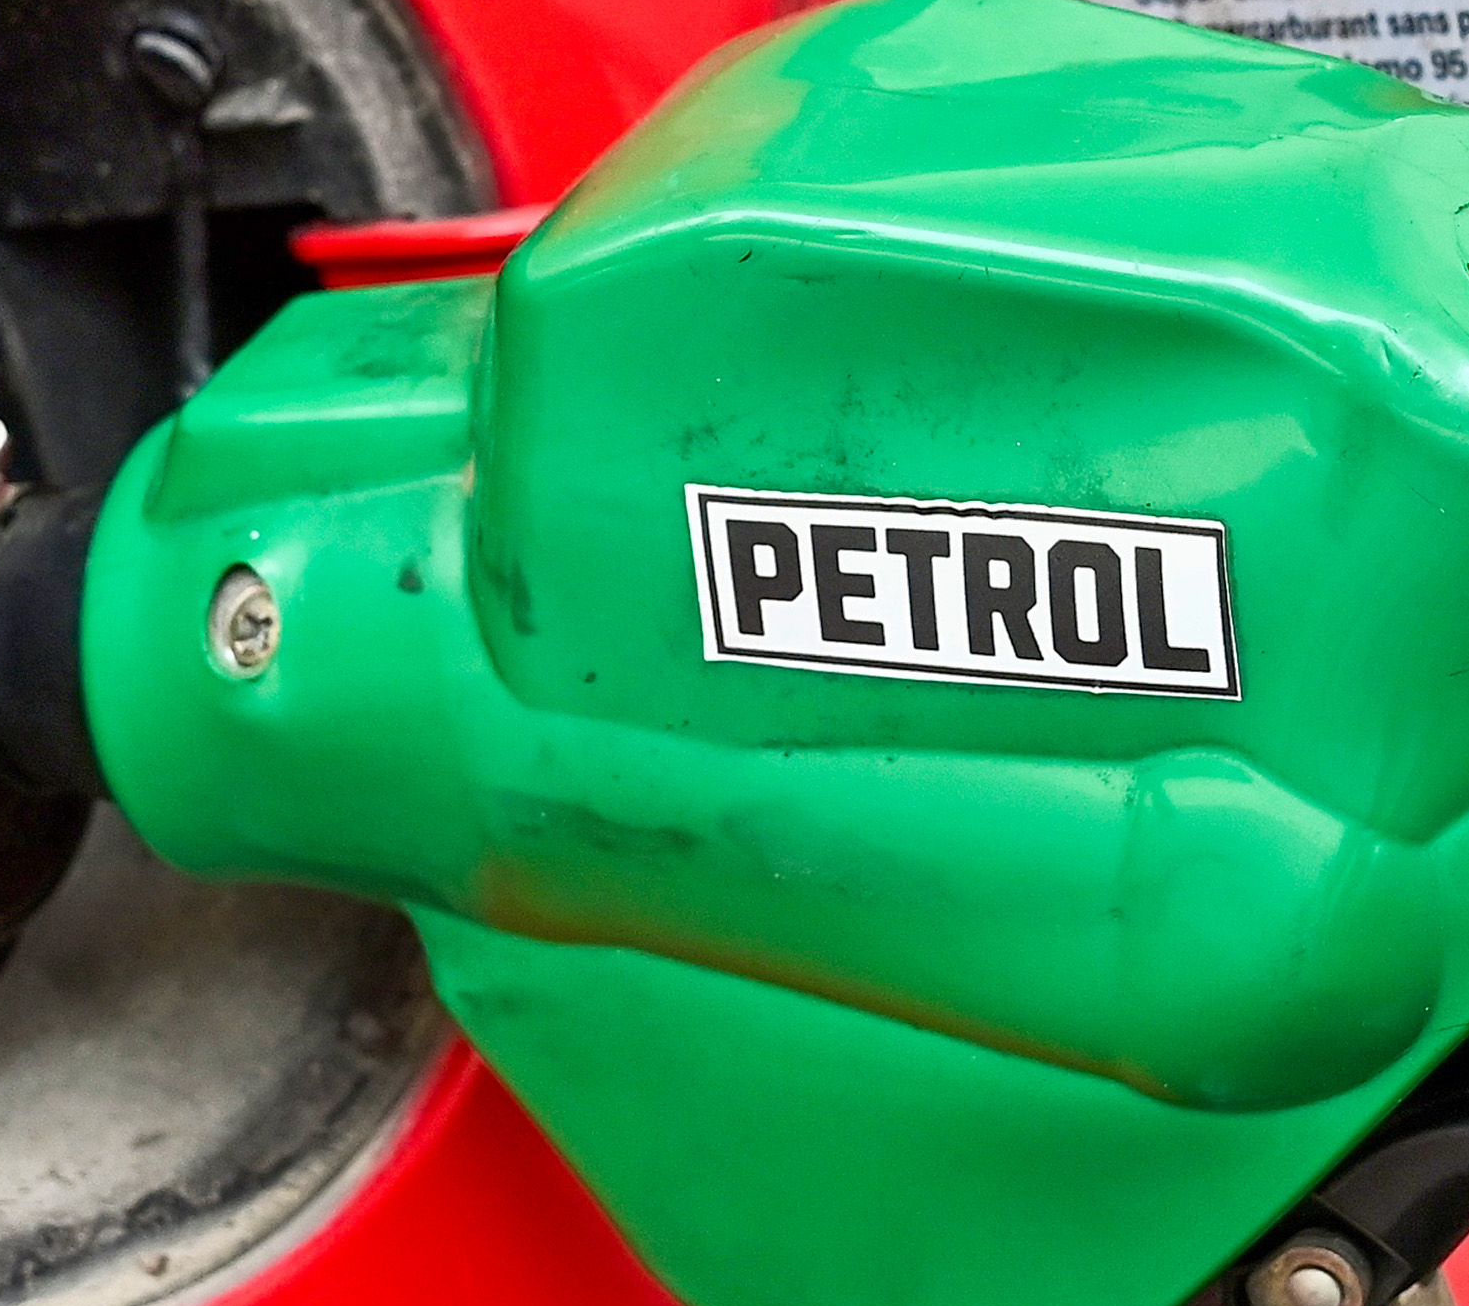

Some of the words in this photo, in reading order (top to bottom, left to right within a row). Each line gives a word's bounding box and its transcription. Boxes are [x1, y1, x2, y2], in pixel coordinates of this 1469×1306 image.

[1388, 11, 1450, 36] sans
[1431, 48, 1468, 81] 95
[725, 519, 1211, 673] PETROL
